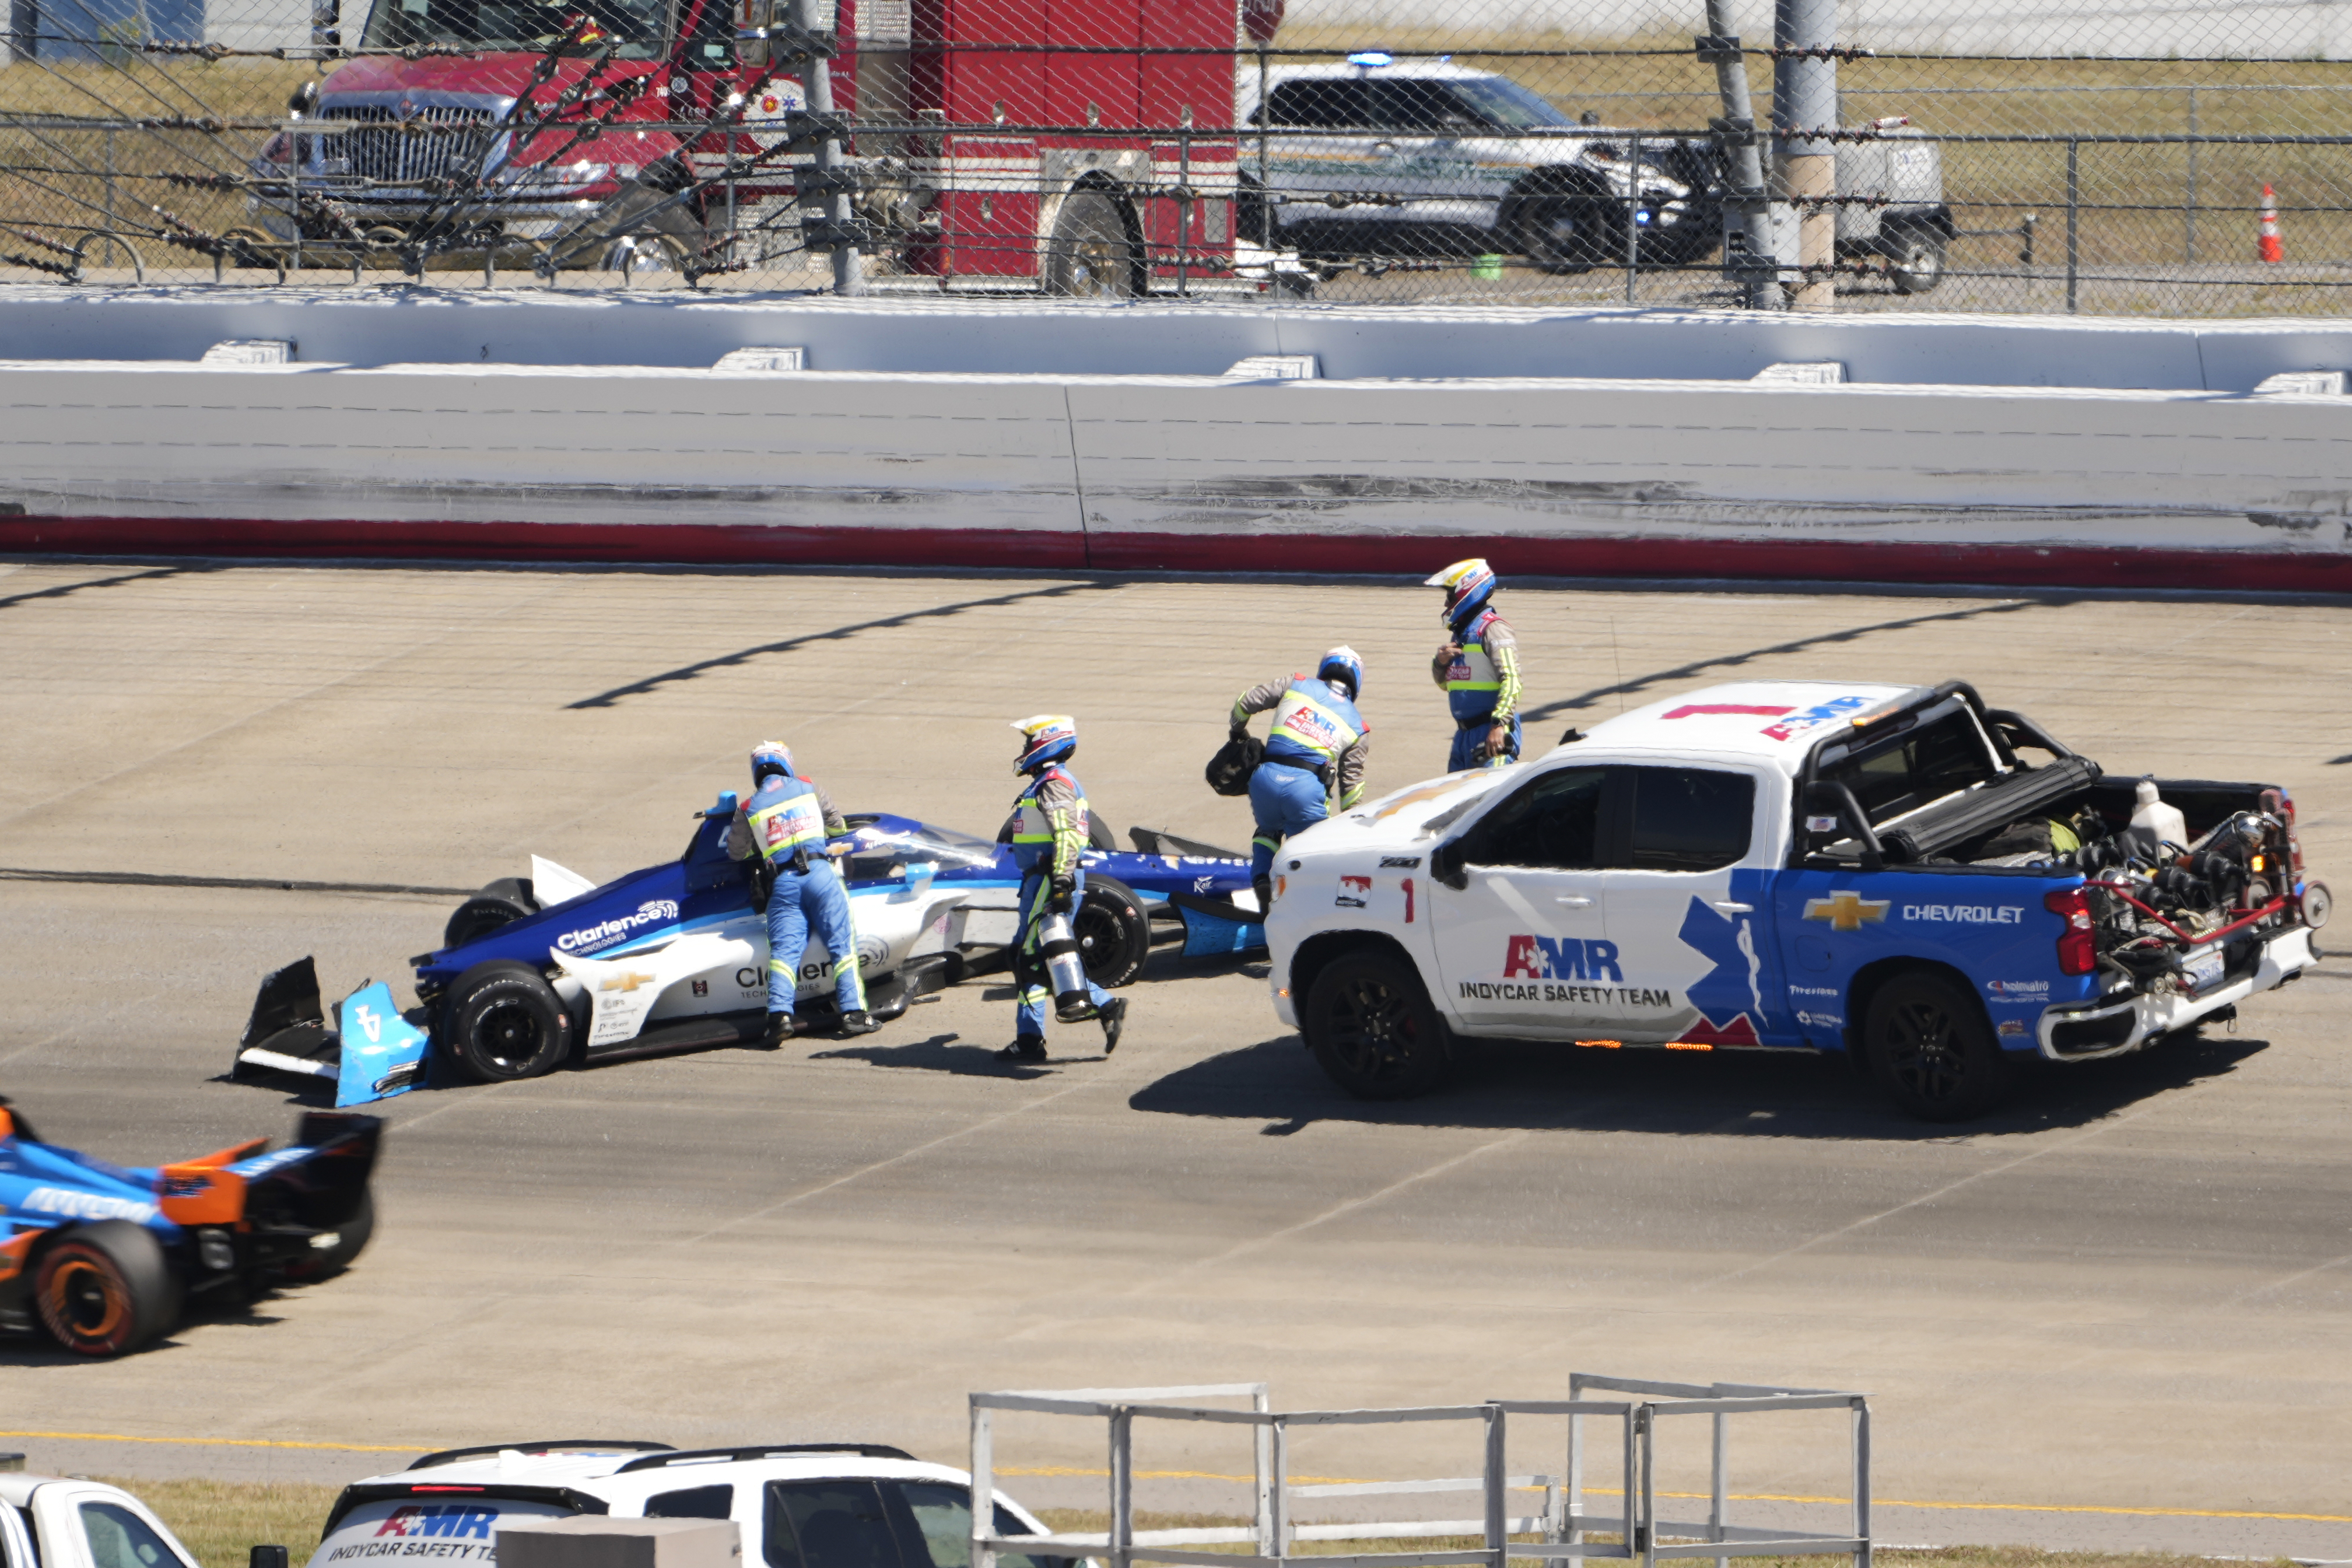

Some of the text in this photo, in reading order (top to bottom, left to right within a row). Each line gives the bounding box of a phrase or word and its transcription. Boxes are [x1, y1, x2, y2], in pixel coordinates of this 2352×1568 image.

[1295, 706, 1337, 736] AMR
[1301, 721, 1334, 745] INDYCAR
[1401, 878, 1414, 923] 1
[1903, 904, 2025, 924] CHEVROLET
[1503, 934, 1624, 982] AMR
[1459, 982, 1672, 1008] INDYCAR SAFETY TEAM
[355, 1005, 381, 1043] 4
[373, 1505, 500, 1540] AMR
[328, 1542, 497, 1563] INDYCAR SAFETY TE
